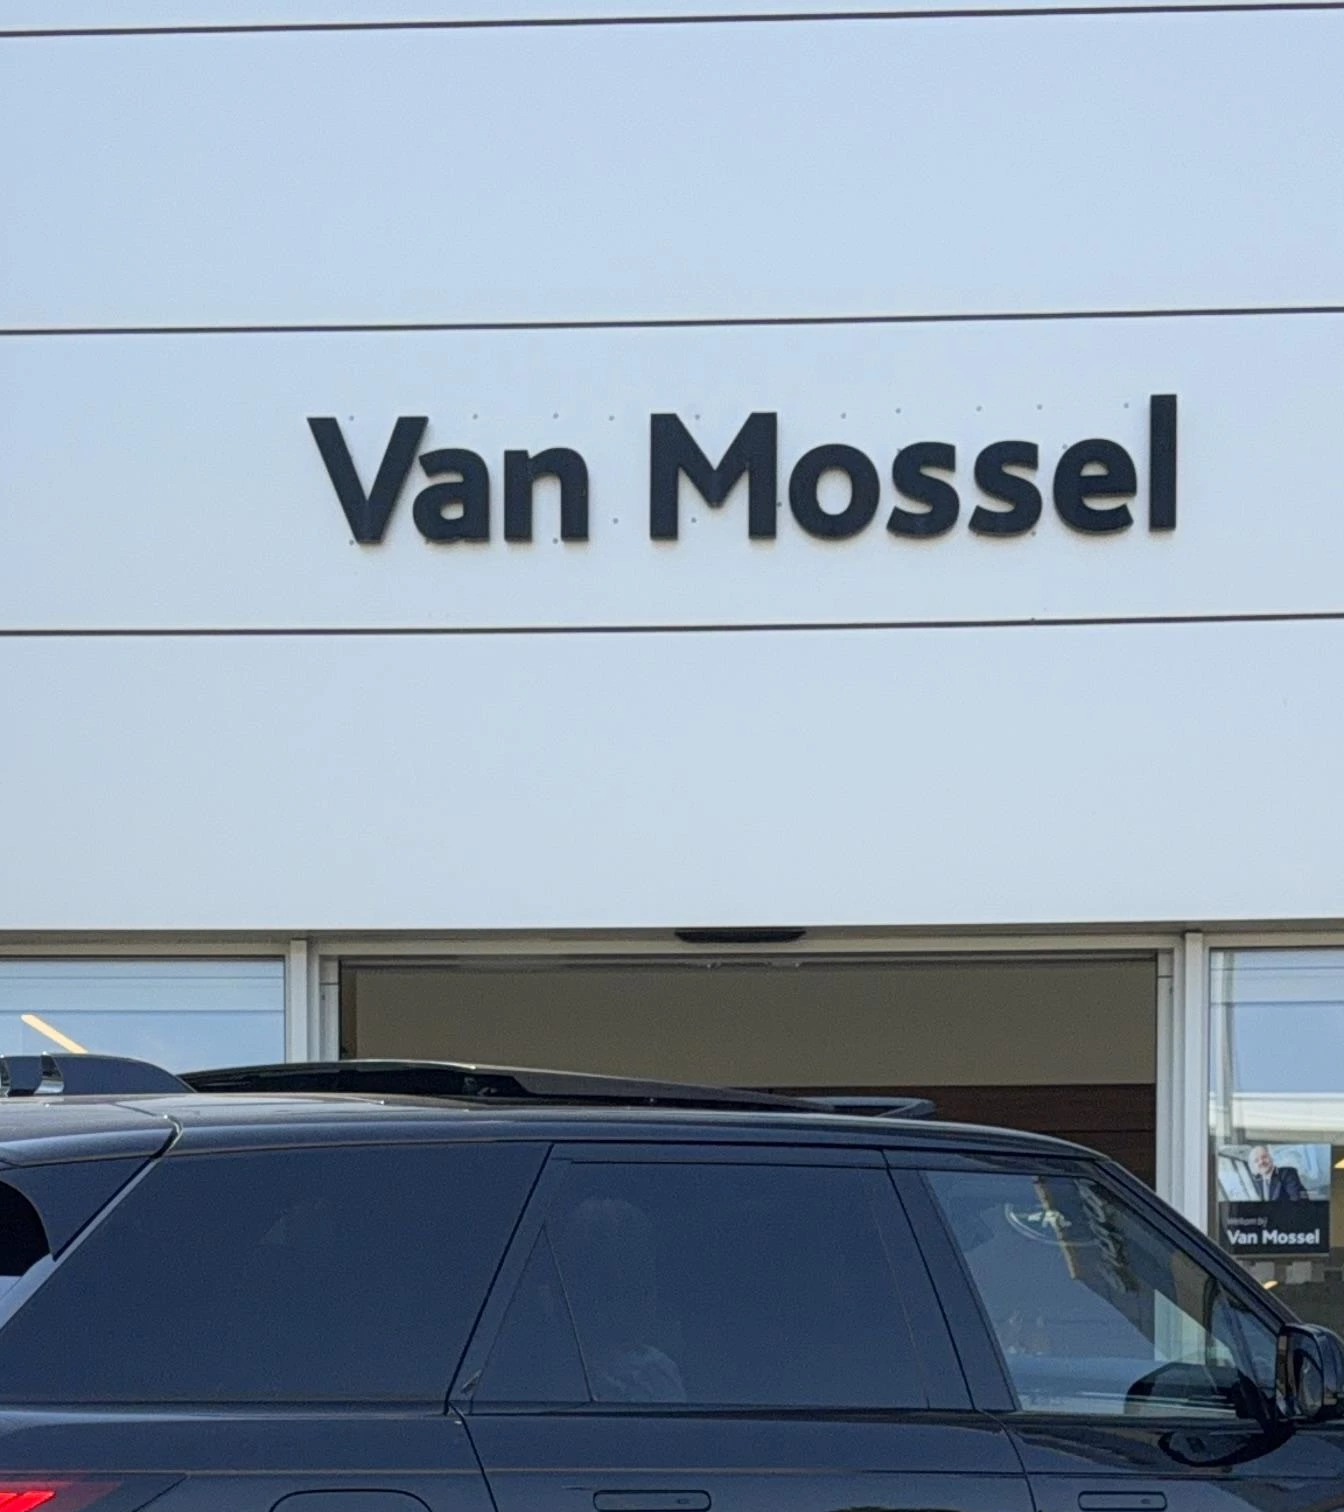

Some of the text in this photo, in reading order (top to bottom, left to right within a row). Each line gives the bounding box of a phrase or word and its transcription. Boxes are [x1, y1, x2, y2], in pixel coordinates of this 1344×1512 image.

[307, 394, 1178, 546] Van Mossel
[1226, 1228, 1320, 1245] Van Mossel
